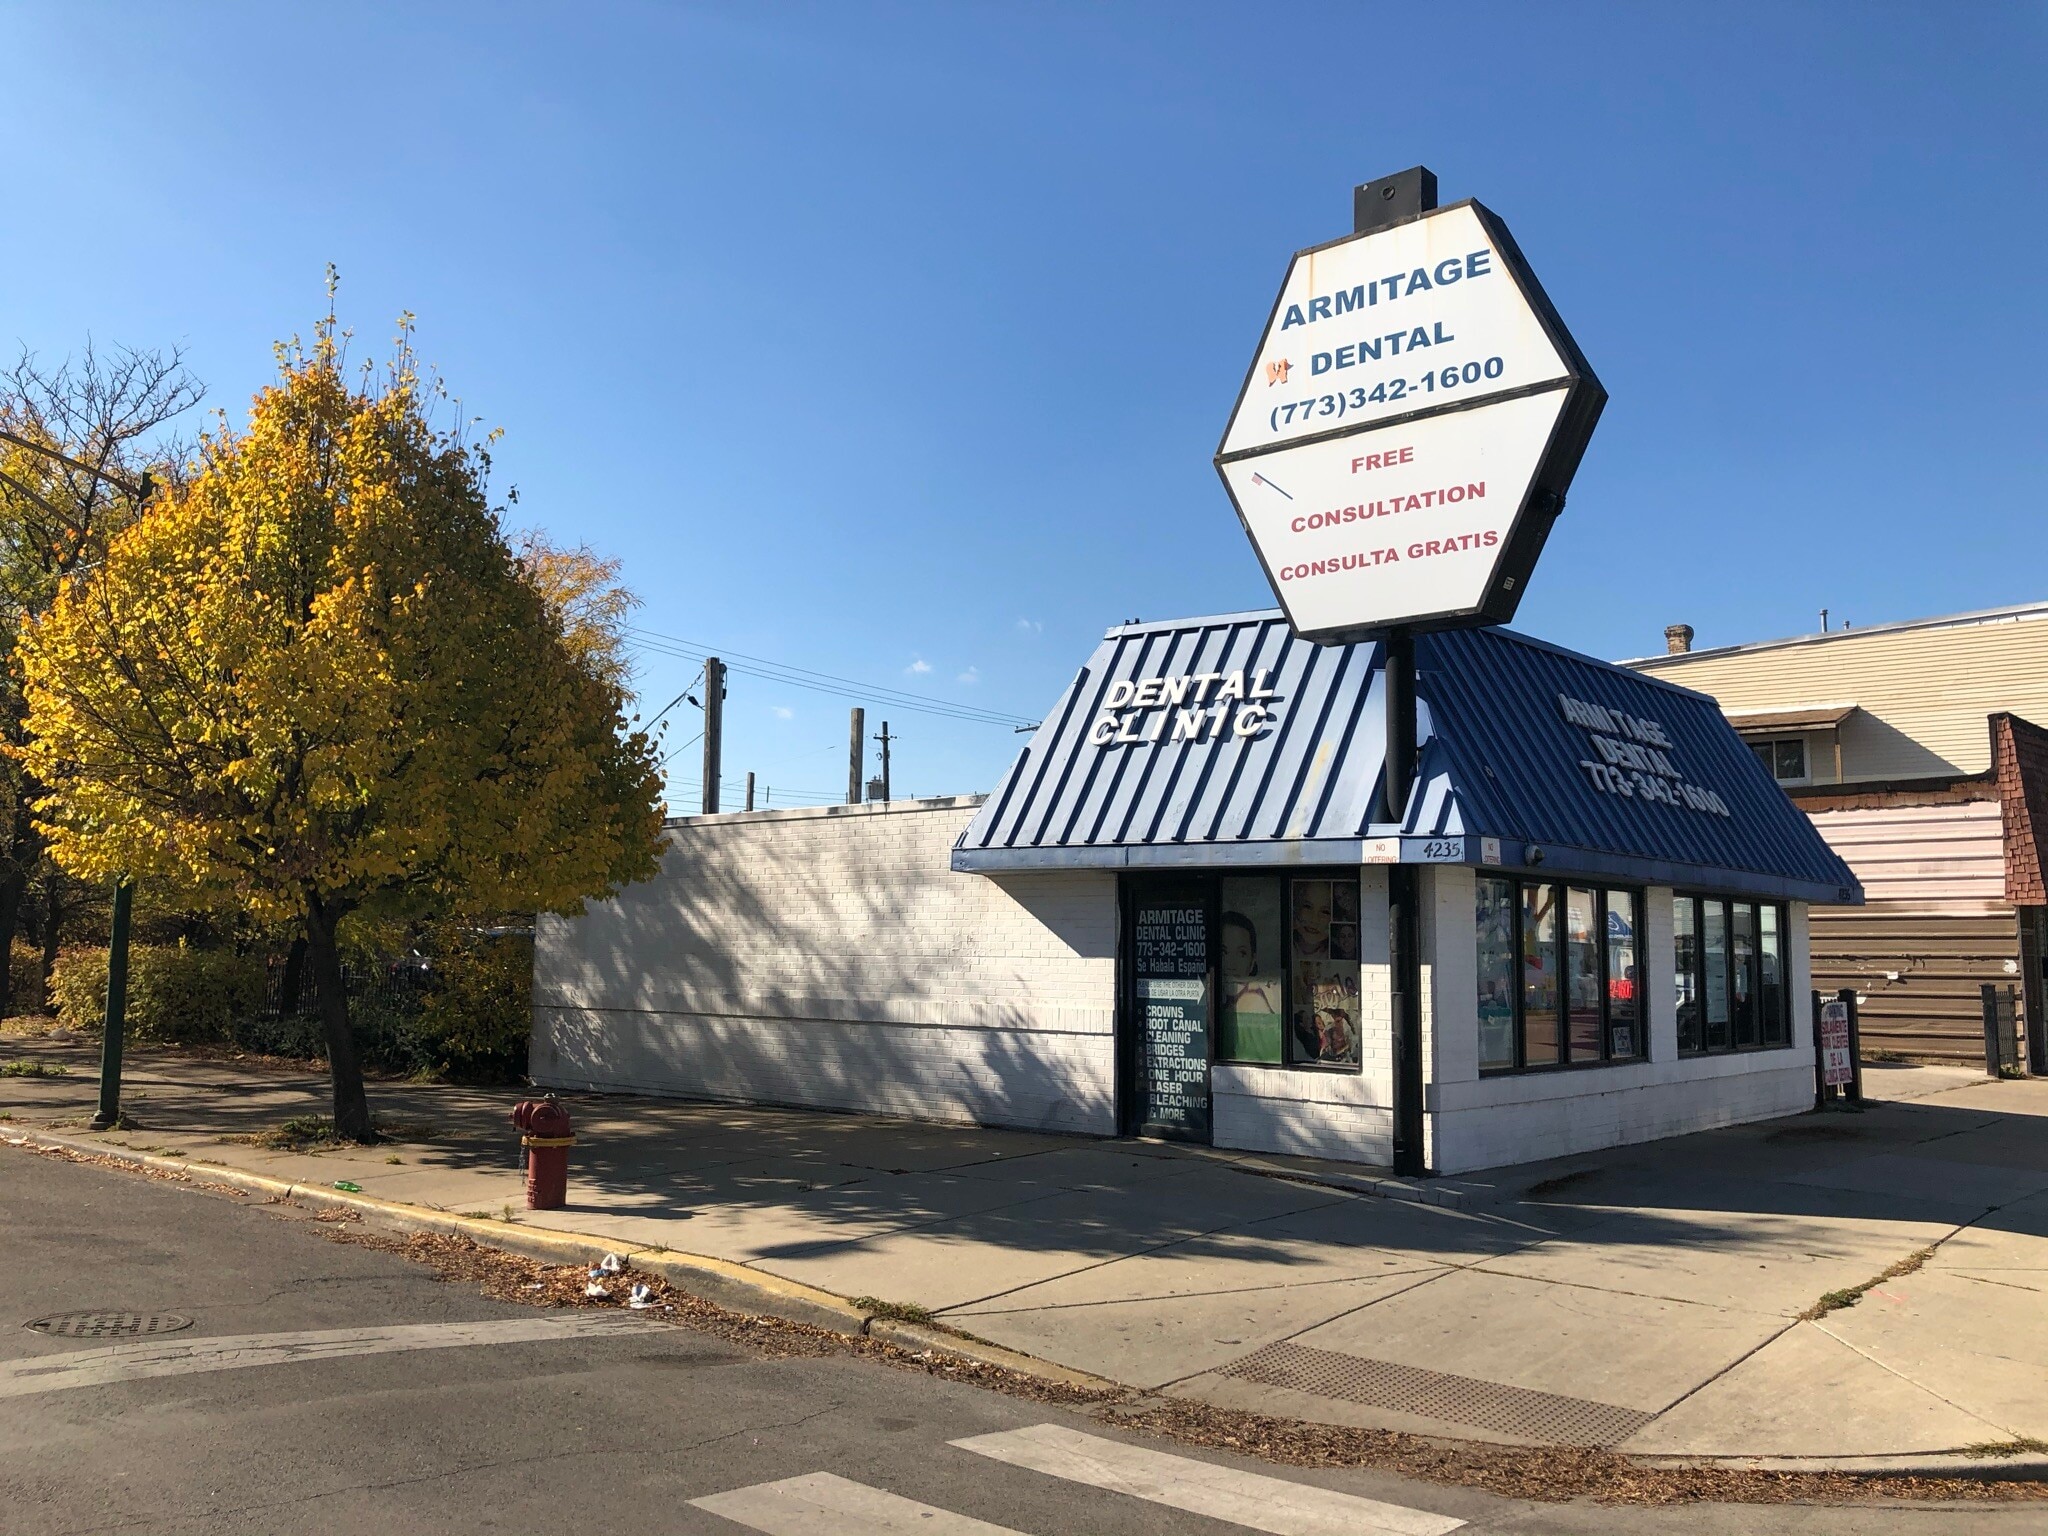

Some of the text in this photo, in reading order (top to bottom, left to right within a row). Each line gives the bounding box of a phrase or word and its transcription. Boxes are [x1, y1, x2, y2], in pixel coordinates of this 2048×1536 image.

[1281, 248, 1491, 330] ARMITAGE
[1310, 321, 1455, 376] DENTAL
[1269, 356, 1505, 432] (773)342-1600
[1351, 446, 1415, 474] FREE
[1290, 481, 1487, 533] CONSULTATION
[1279, 530, 1500, 581] CONSULTA GRATIS
[1104, 668, 1275, 710] DENTAL
[1089, 705, 1267, 746] CLINIC
[1557, 693, 1674, 749] ARMITAGE
[1590, 734, 1683, 779] DENTAL
[1579, 760, 1731, 817] 773-342-1600
[1375, 843, 1386, 852] NO
[1423, 842, 1461, 859] 4235
[1139, 909, 1204, 924] ARMITAGE
[1136, 926, 1206, 940] DENTAL CLINIC
[1137, 942, 1206, 956] 773-342-1600
[1137, 958, 1146, 972] Se
[1178, 958, 1207, 976] Español
[1146, 1005, 1184, 1018] CROWNS
[1146, 1018, 1203, 1032] ROOT CANAL
[1146, 1031, 1191, 1044] CLEANING
[1146, 1044, 1185, 1056] BRIDGES
[1146, 1056, 1207, 1071] EXTRACTIONS
[1148, 1069, 1203, 1083] ONE HOUR
[1149, 1081, 1183, 1094] LASER
[1149, 1093, 1208, 1109] BLEACHING
[1160, 1107, 1185, 1121] MORE
